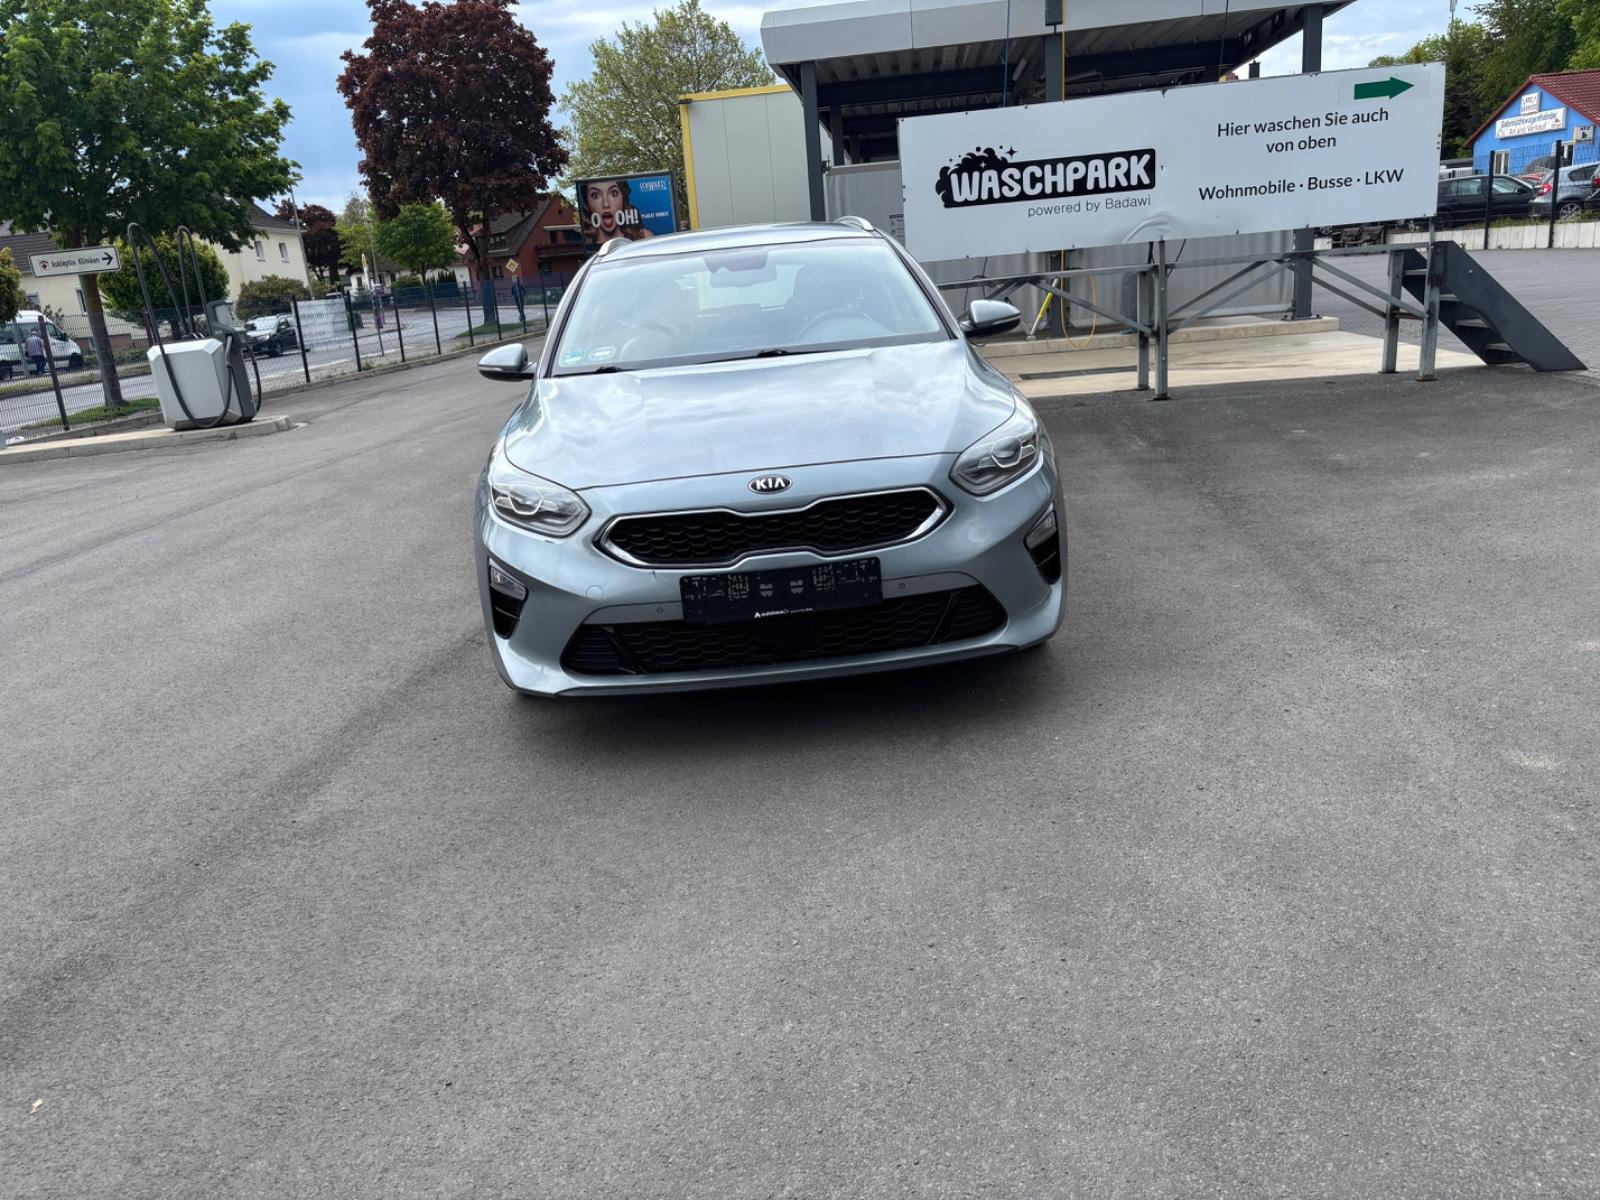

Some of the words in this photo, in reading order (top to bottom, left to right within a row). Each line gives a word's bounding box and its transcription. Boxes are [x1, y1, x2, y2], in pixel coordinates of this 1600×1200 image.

[1217, 122, 1250, 138] Hier
[1254, 115, 1321, 133] waschen
[1324, 112, 1348, 127] Sie
[1351, 107, 1389, 124] auch
[1266, 140, 1294, 153] von
[1297, 135, 1337, 150] oben
[950, 153, 1151, 203] WASCHPARK
[1198, 178, 1296, 201] Wohnmobile
[1307, 175, 1353, 191] Busse
[1365, 168, 1405, 186] LKW
[1027, 201, 1081, 218] powered
[1086, 200, 1100, 212] by
[1105, 194, 1151, 210] Badawi
[755, 477, 786, 490] KIA
